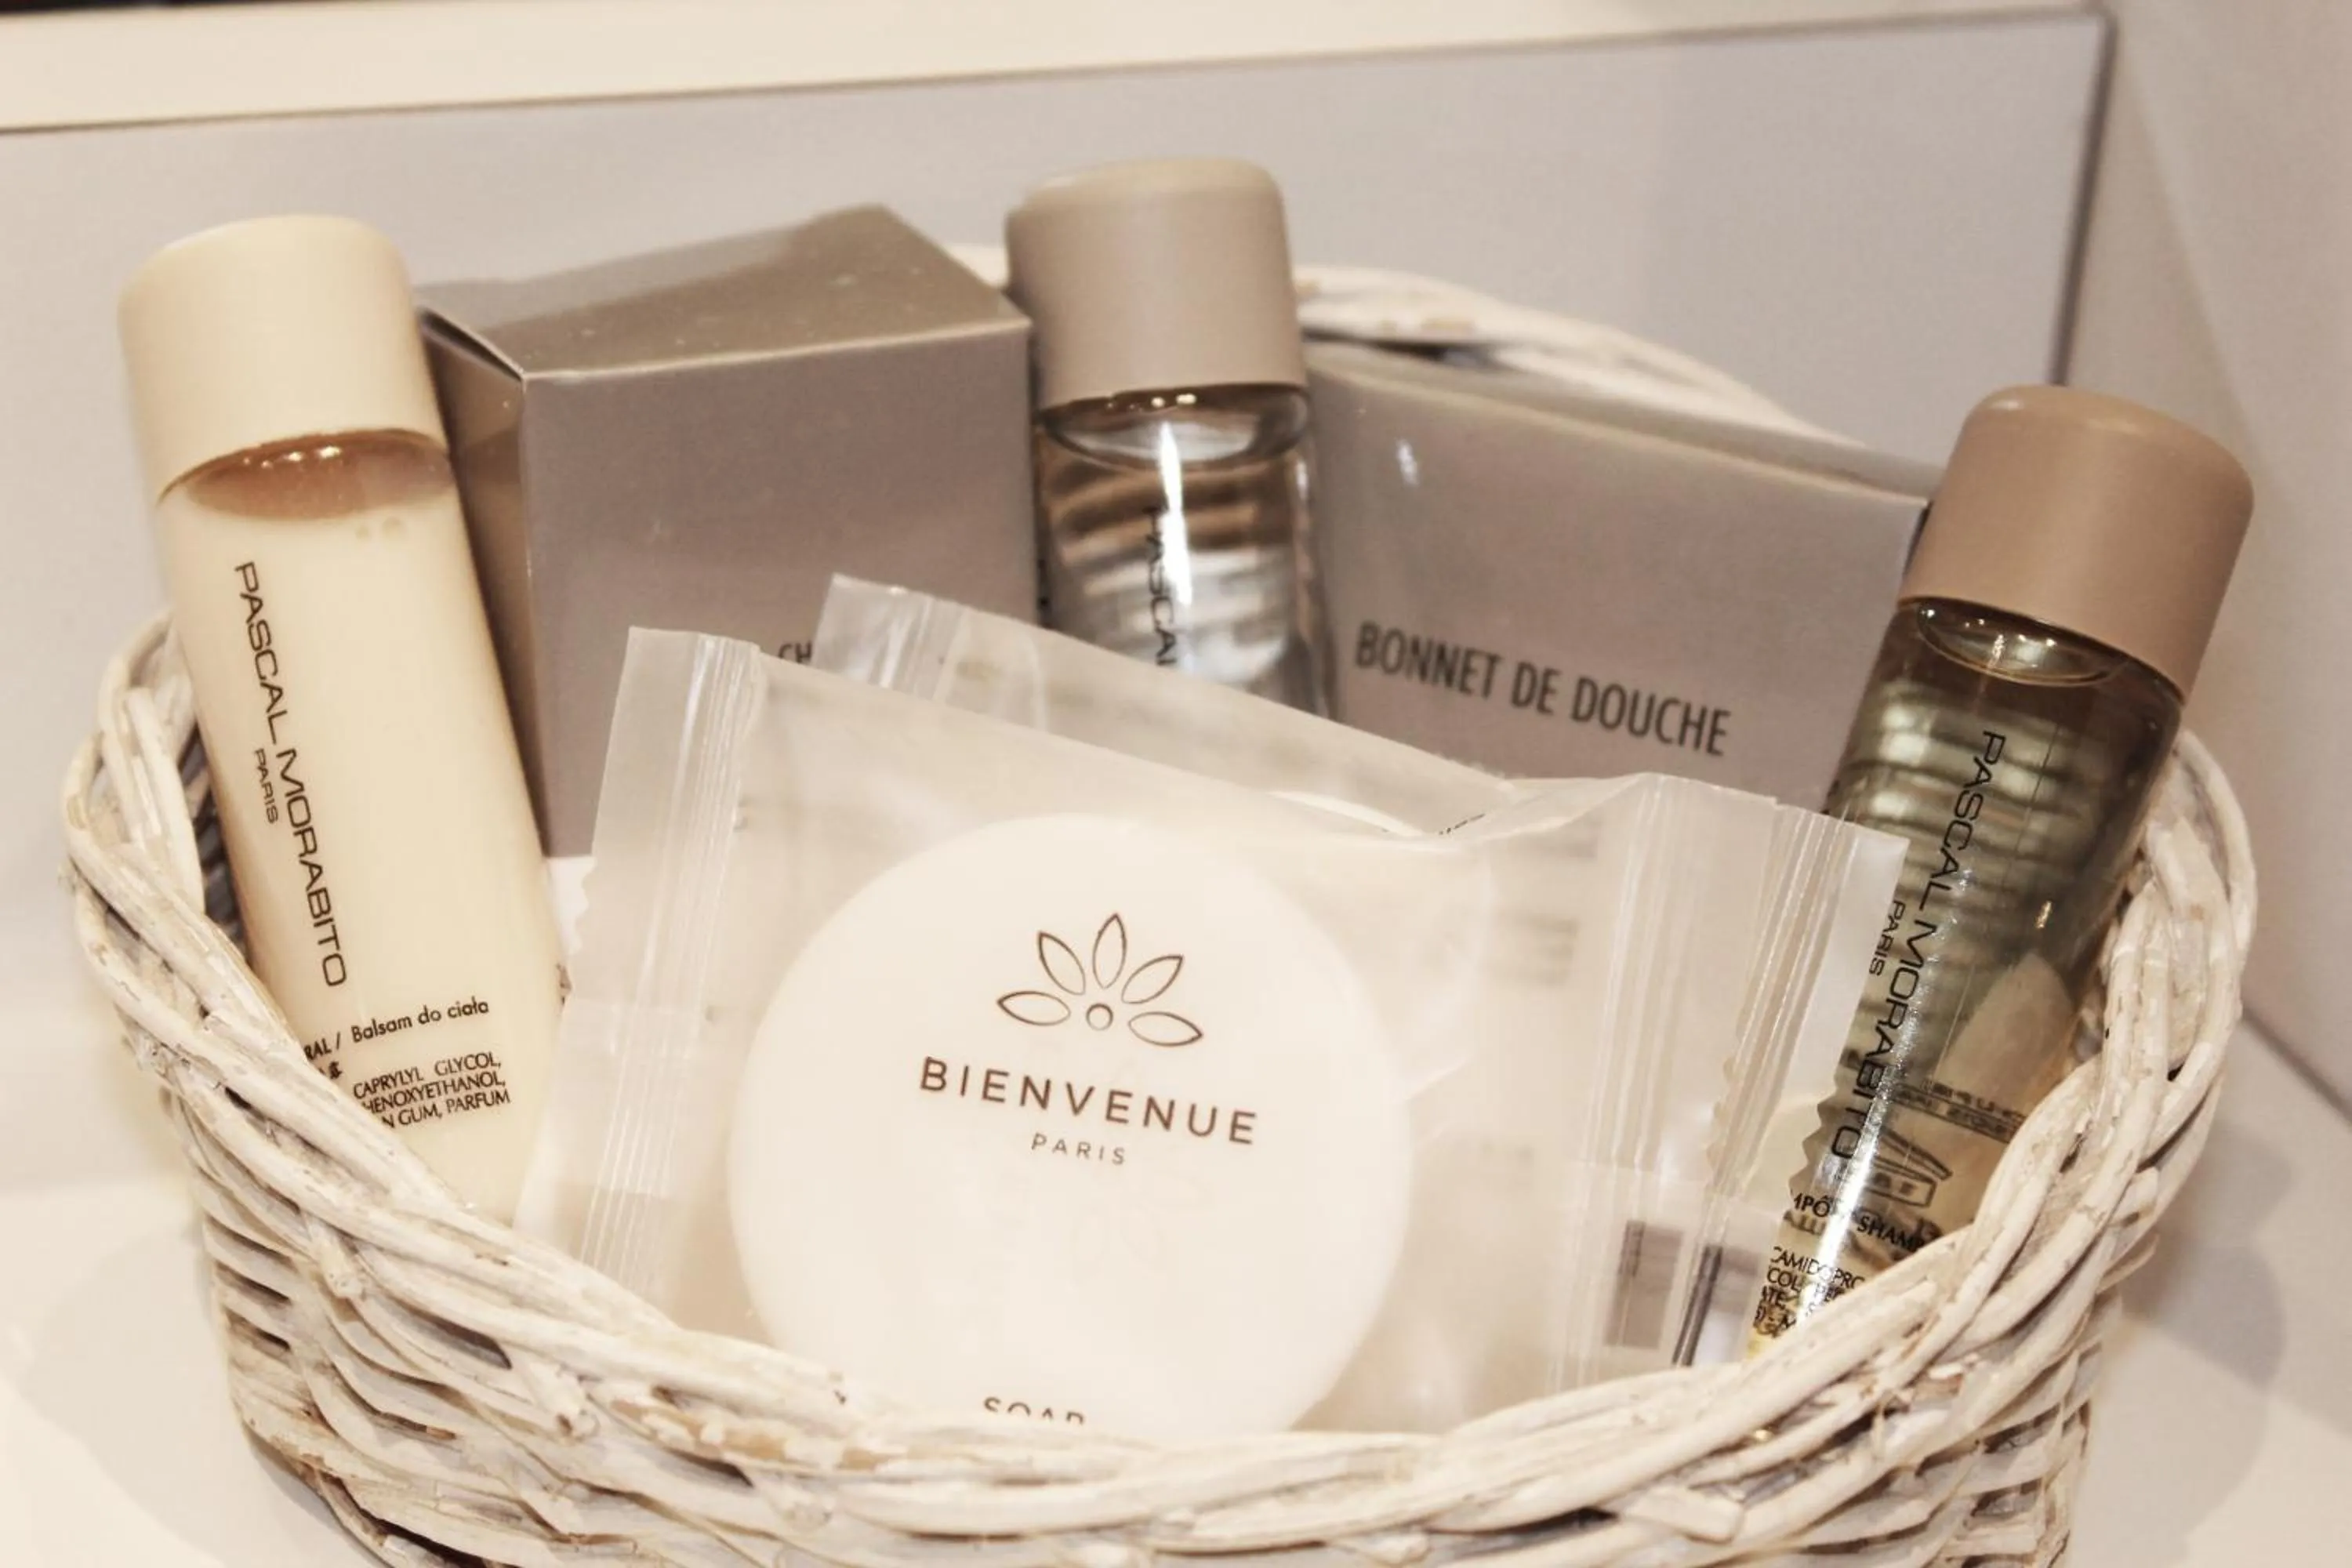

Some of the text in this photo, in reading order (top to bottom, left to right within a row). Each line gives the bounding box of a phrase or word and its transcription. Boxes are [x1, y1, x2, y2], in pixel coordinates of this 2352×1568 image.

[1355, 621, 1730, 757] BONNET DE DOUCHE
[234, 561, 288, 745] PASCAL
[276, 748, 347, 987] MORABITO
[254, 748, 279, 825] PARIS
[1831, 730, 2006, 1160] PASCAL MORABITO
[1868, 899, 1907, 977] PARIS
[350, 1017, 412, 1044] Balsam
[417, 1004, 441, 1025] do
[353, 1066, 424, 1099] CAPRYLYL
[434, 1051, 502, 1076] GLYCOL,
[398, 1103, 443, 1126] GUM,
[446, 1088, 510, 1114] PARFUM
[920, 1055, 1257, 1145] BIENVENUE
[1030, 1132, 1127, 1166] PARIS
